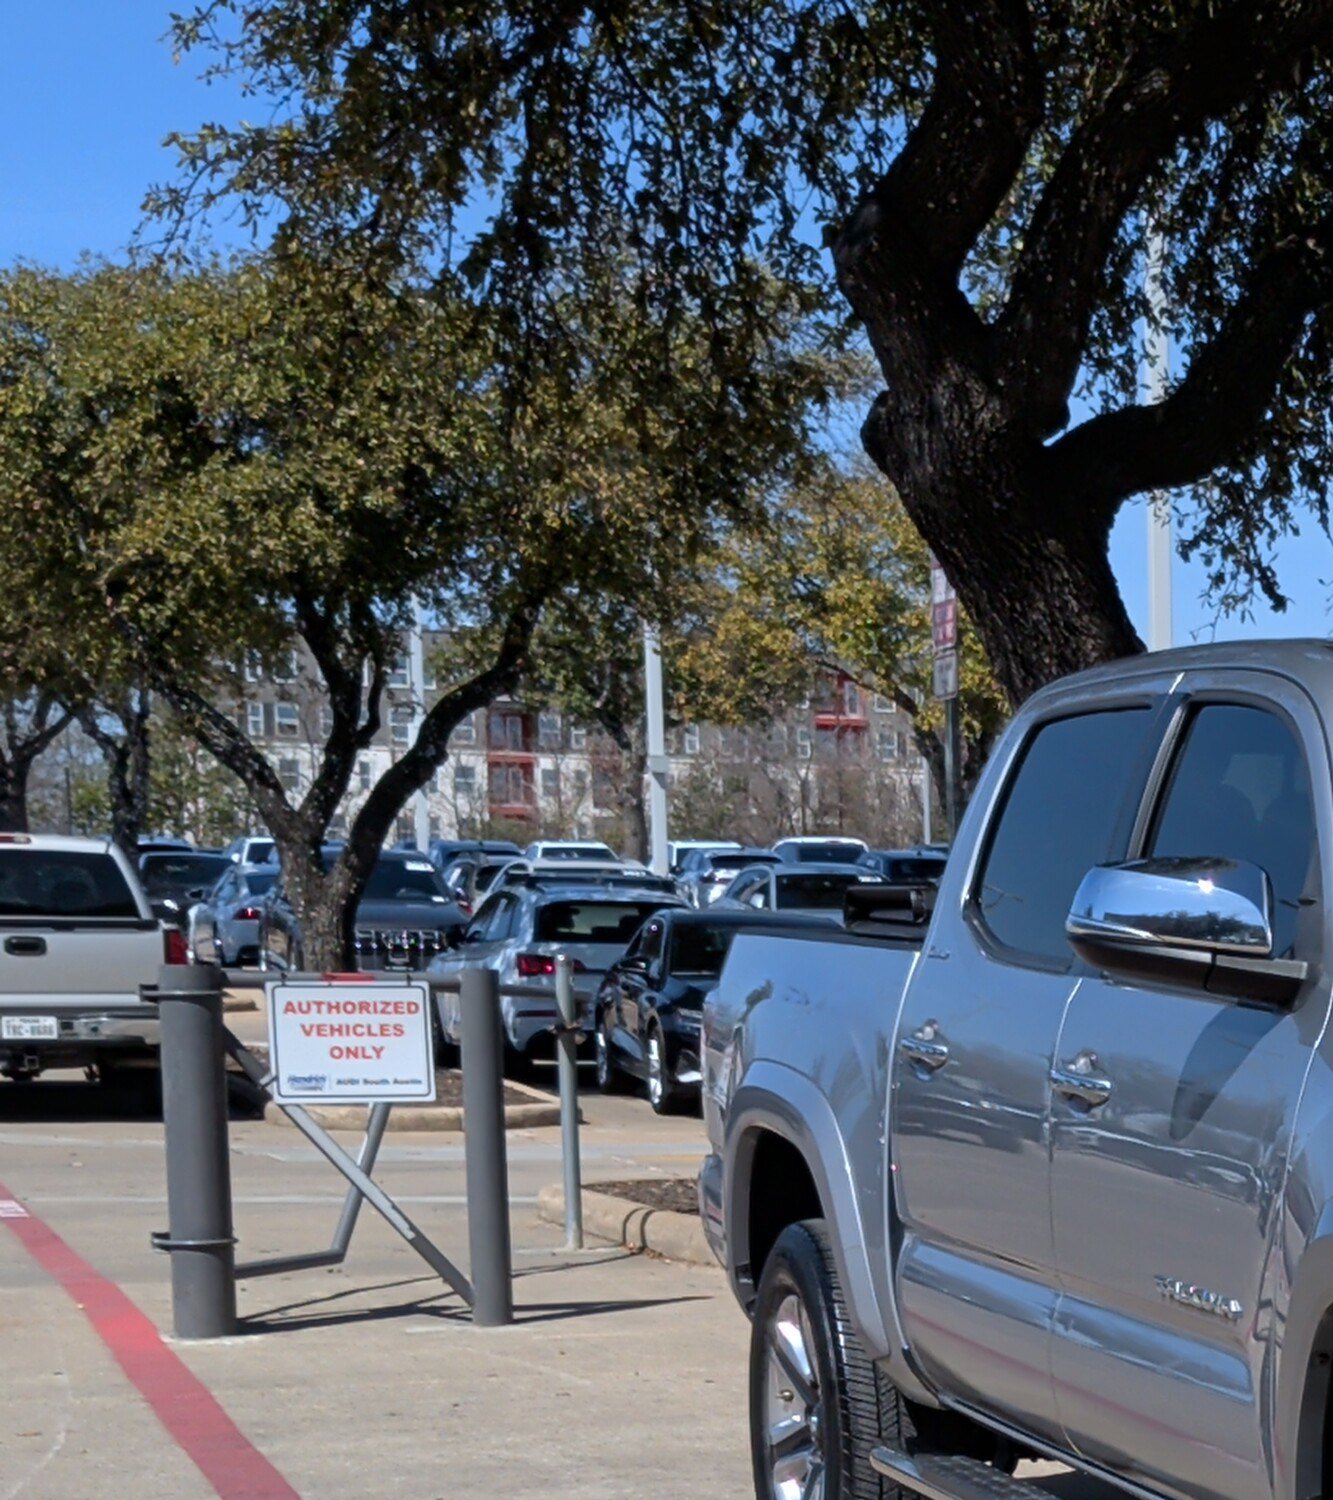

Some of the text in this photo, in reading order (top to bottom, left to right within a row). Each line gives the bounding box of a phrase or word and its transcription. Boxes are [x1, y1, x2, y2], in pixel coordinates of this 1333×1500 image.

[283, 1001, 420, 1015] AUTHORIZED
[300, 1023, 405, 1037] VEHICLES
[329, 1046, 385, 1060] ONLY
